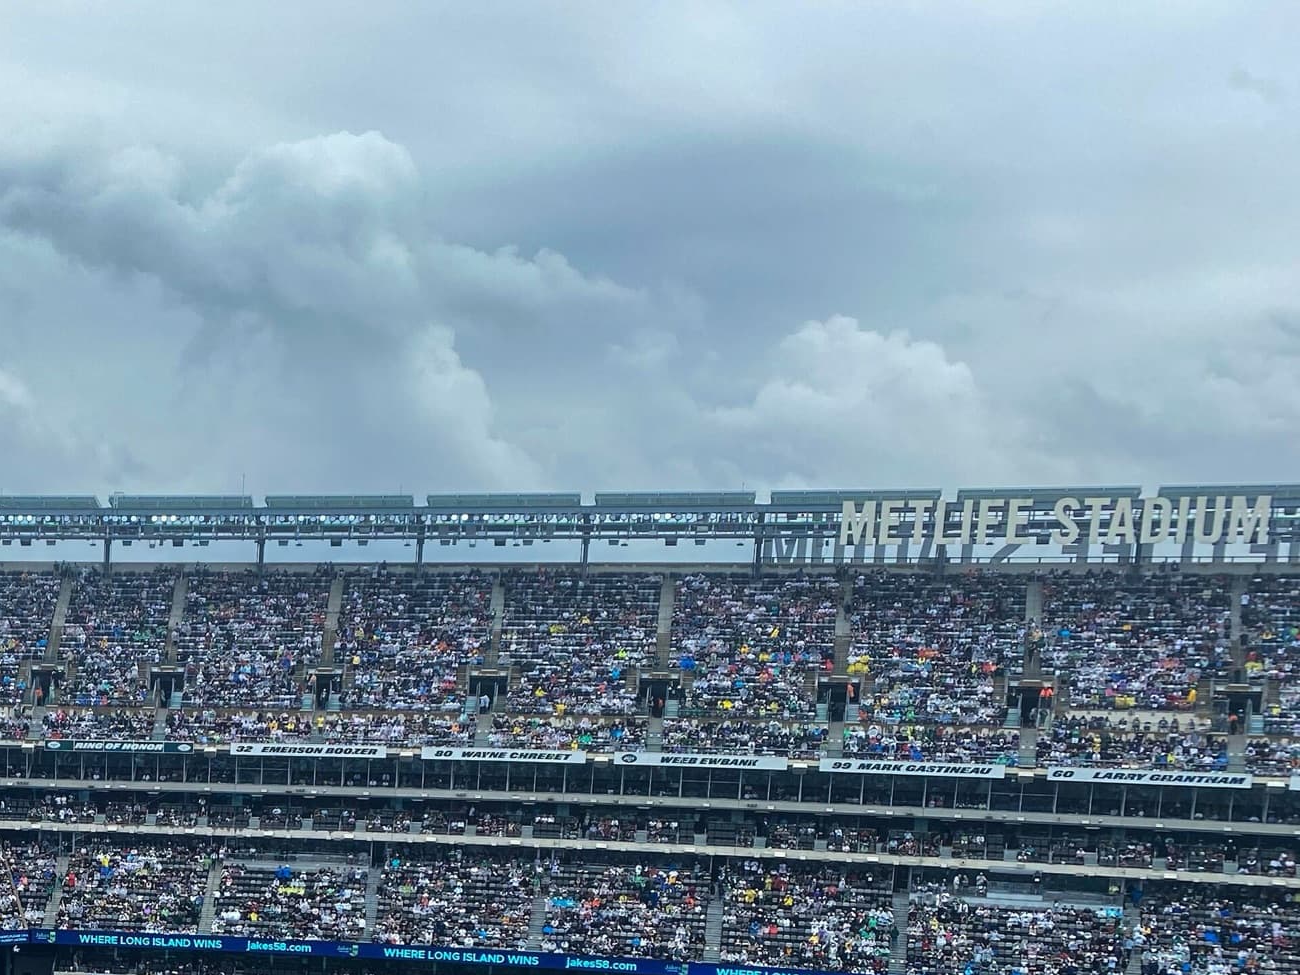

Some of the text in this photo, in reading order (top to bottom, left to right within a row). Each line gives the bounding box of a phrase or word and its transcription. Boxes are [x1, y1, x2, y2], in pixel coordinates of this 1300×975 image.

[838, 495, 1273, 546] METLIFE STADIUM
[121, 743, 163, 751] HONOR
[261, 746, 322, 754] EMERSON
[325, 747, 378, 755] BOOZER
[509, 752, 572, 761] CHREBET
[660, 756, 758, 767] WEEB EWBANK
[832, 762, 992, 775] 99 MARK GASTINEAU
[1052, 770, 1245, 785] 60 LARRY GRANTHAM
[79, 935, 222, 949] WHERE LONG ISLAND WINS
[246, 940, 312, 953] jakes58.com
[383, 948, 539, 966] WHERE LONG ISLAND WINS
[565, 957, 637, 972] jakes58.com
